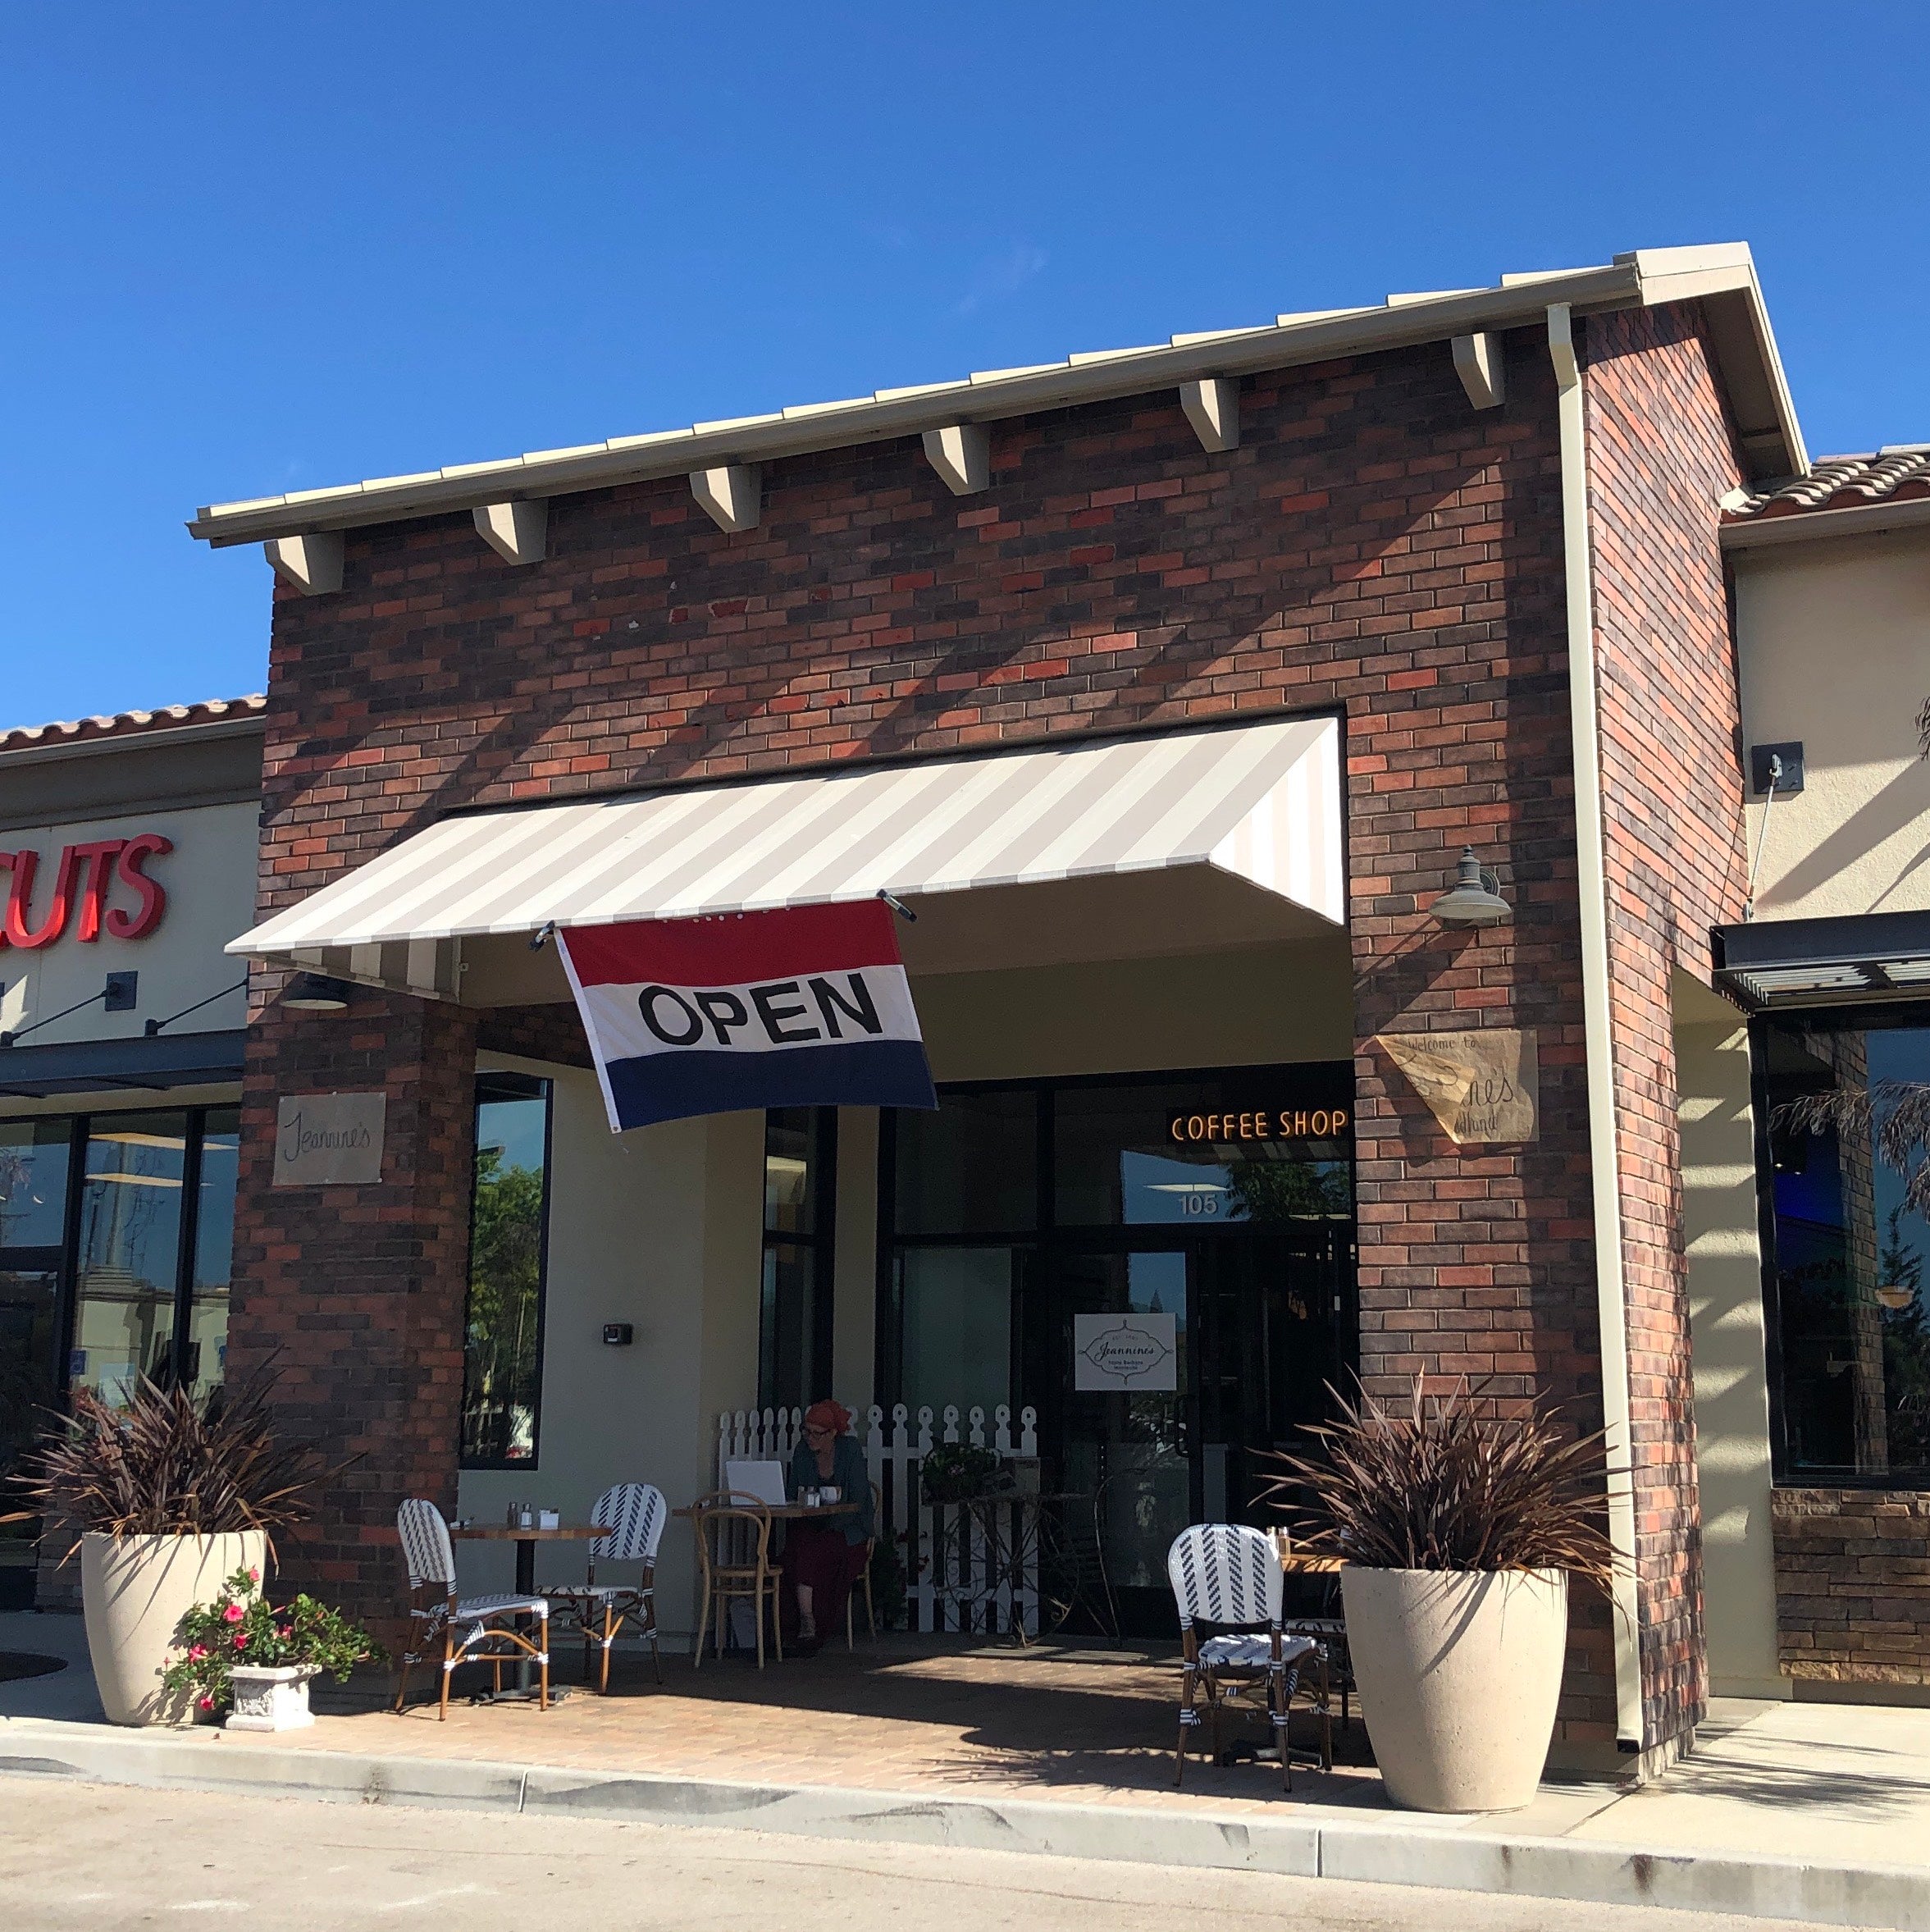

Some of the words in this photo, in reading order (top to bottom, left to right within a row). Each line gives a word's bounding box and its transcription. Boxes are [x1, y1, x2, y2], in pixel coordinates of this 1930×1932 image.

[638, 972, 883, 1046] OPEN
[1408, 1039, 1456, 1051] Welcome
[1463, 1036, 1476, 1048] to
[1172, 1112, 1268, 1140] COFFEE
[1279, 1110, 1347, 1136] SHOP
[1179, 1194, 1219, 1215] 105
